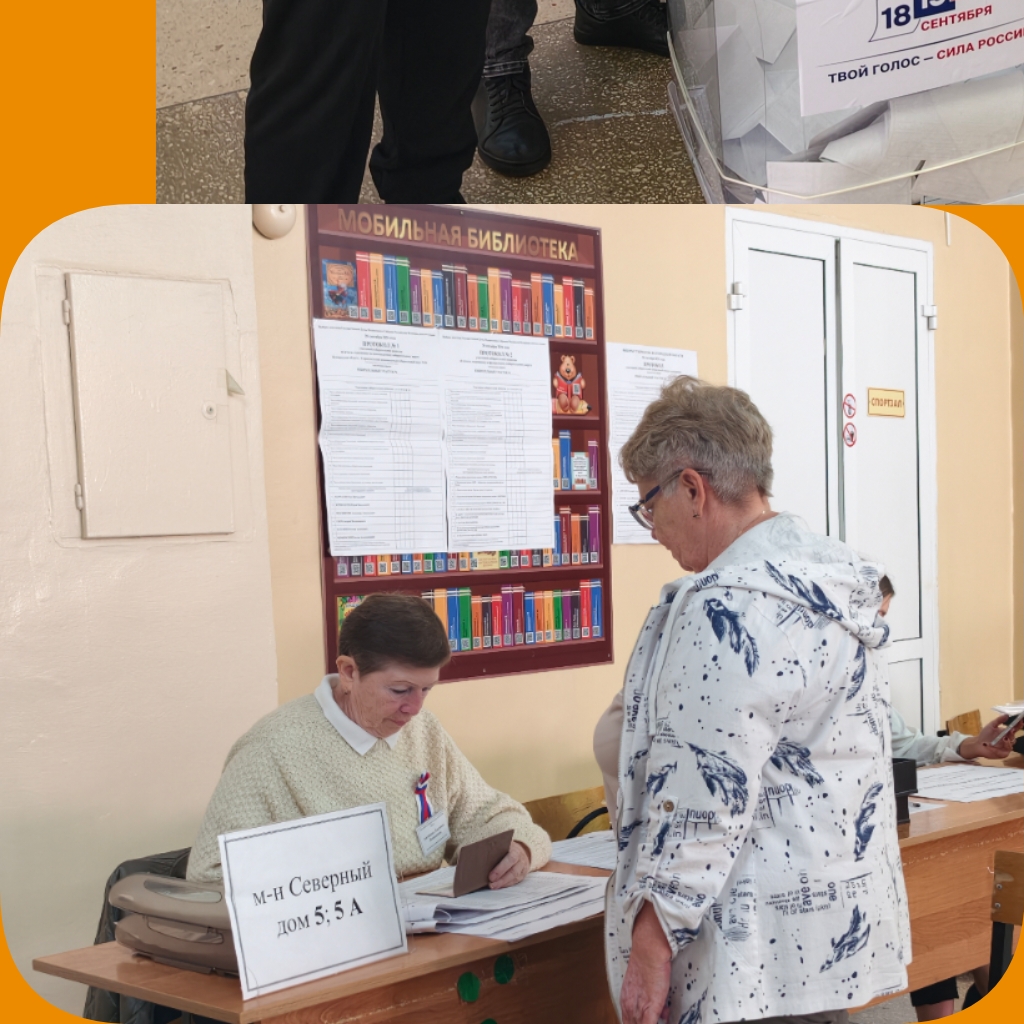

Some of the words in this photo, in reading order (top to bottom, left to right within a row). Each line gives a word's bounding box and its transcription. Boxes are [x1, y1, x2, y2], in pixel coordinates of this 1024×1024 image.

[881, 3, 911, 29] 18
[920, 4, 993, 32] СЕНТЯБРЯ
[828, 64, 869, 84] ТВОЙ
[872, 55, 920, 75] ГОЛОС
[936, 43, 975, 61] СИЛА
[338, 208, 462, 247] МОБИЛЬНАЯ
[468, 227, 579, 261] БИБЛИОТЕКА
[252, 886, 284, 907] м-н
[289, 860, 373, 897] Северный
[276, 914, 310, 938] дом
[313, 905, 331, 926] 5;
[334, 899, 345, 920] 5
[350, 897, 363, 917] А
